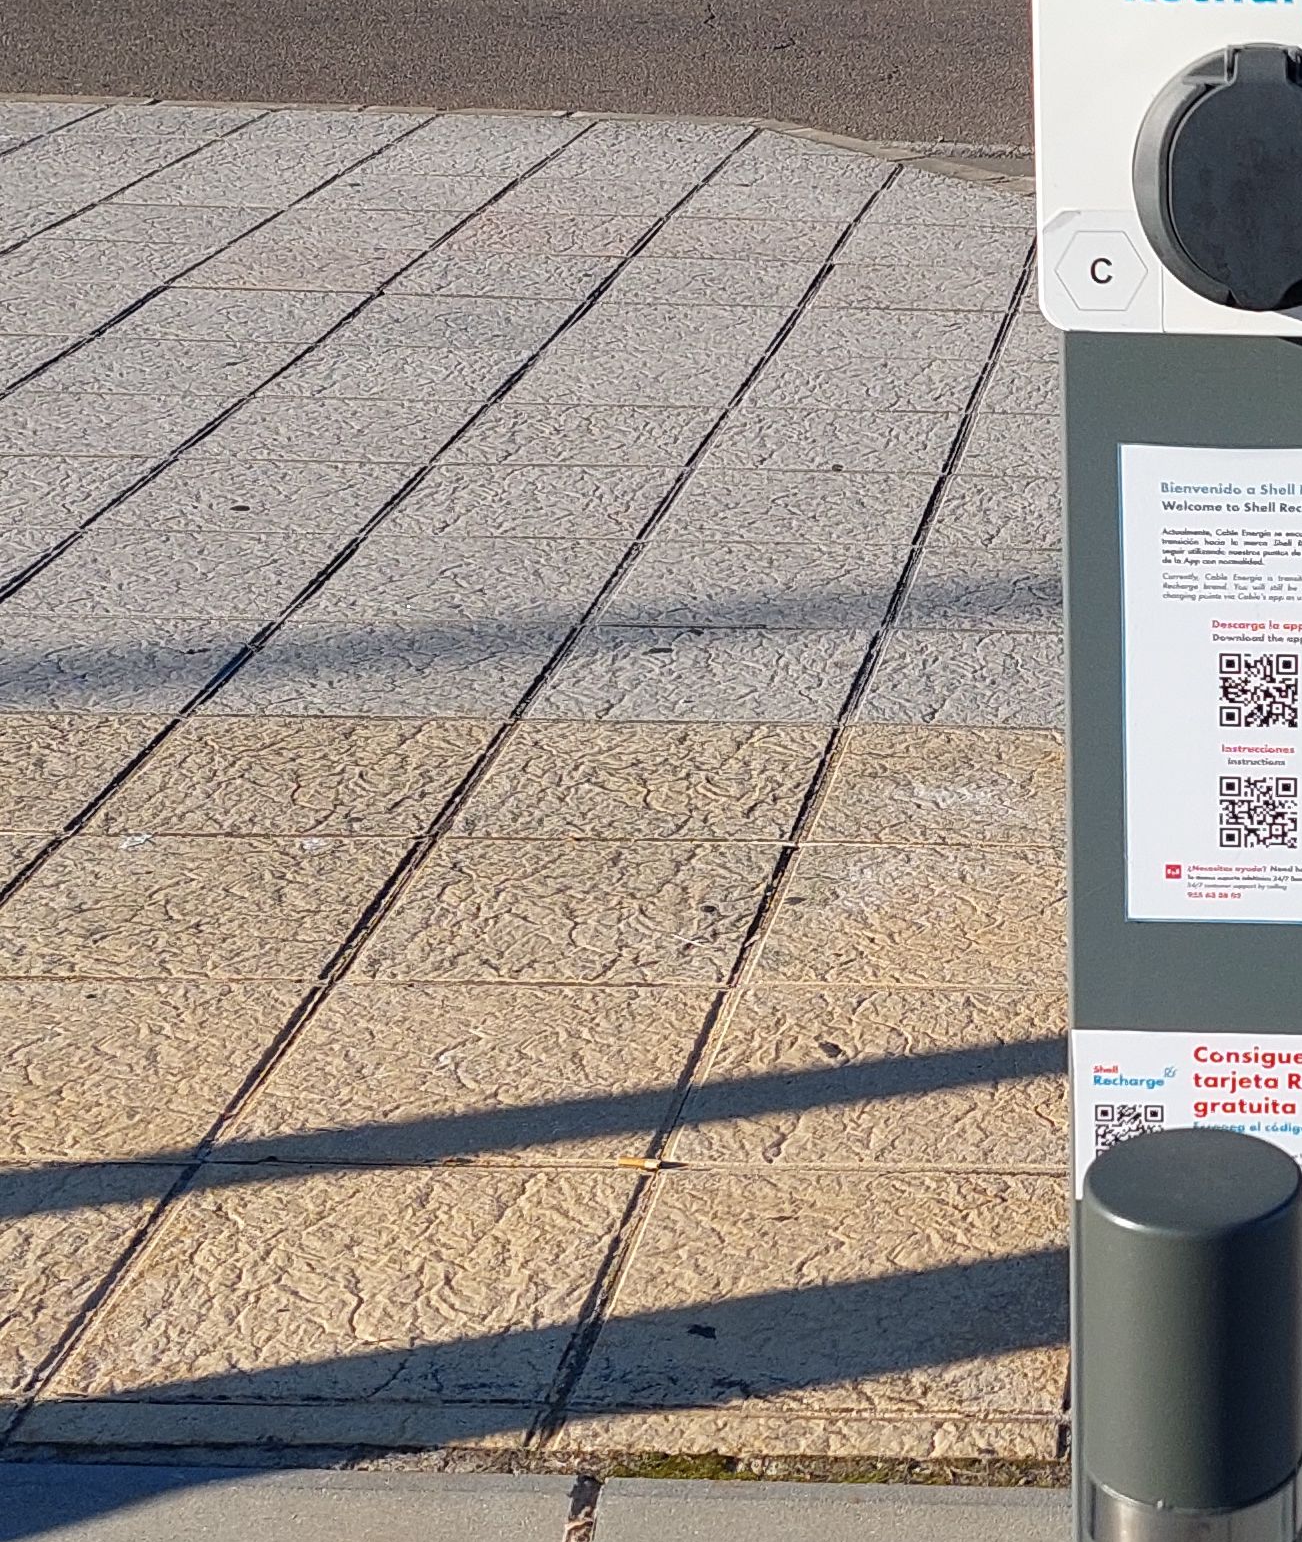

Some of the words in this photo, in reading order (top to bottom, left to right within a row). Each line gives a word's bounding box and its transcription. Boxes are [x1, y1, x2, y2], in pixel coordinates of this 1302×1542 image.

[1090, 258, 1113, 284] C
[1160, 481, 1242, 495] Bienvenido
[1247, 487, 1256, 495] a
[1260, 483, 1296, 496] Shell
[1161, 500, 1223, 512] Welcome
[1226, 502, 1240, 512] to
[1244, 501, 1276, 513] Shell
[1212, 620, 1265, 632] Descarga
[1269, 620, 1280, 630] la
[1212, 634, 1265, 642] Download
[1268, 634, 1284, 642] the
[1221, 743, 1295, 754] Instrucciones
[1093, 1065, 1119, 1074] Shell
[1093, 1073, 1165, 1089] Recharge
[1193, 1070, 1279, 1094] tarjeta
[1193, 1096, 1297, 1118] gratuita
[1249, 1122, 1261, 1132] el
